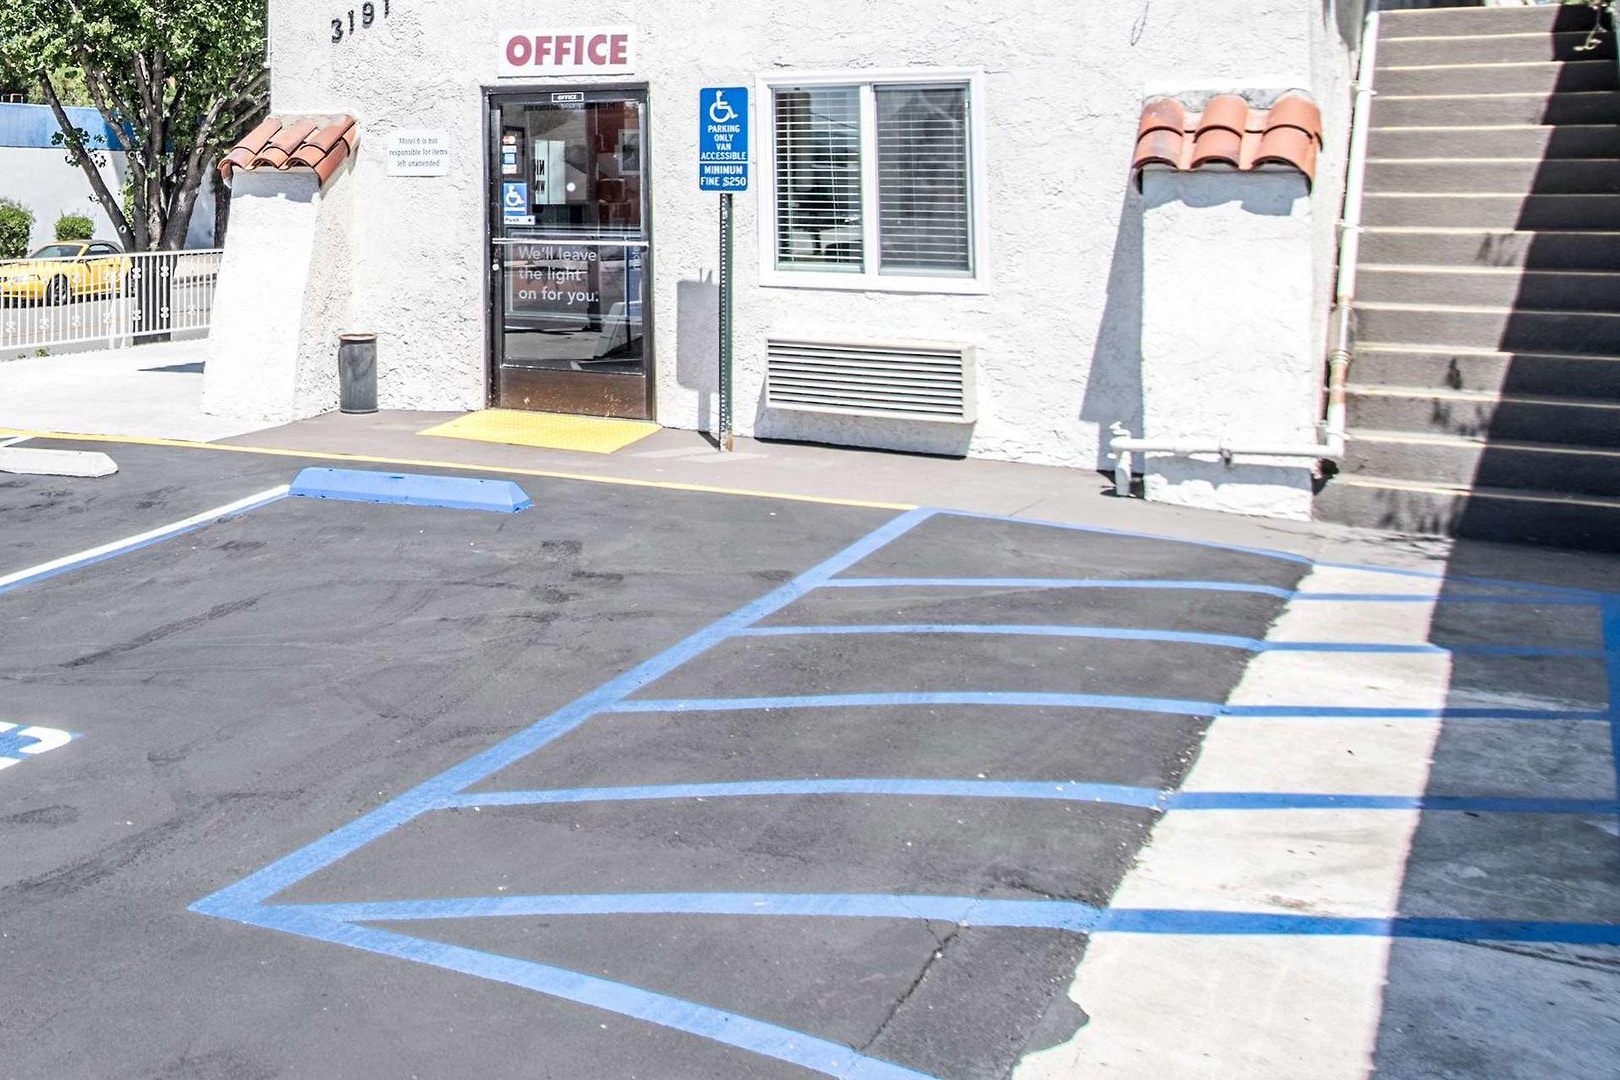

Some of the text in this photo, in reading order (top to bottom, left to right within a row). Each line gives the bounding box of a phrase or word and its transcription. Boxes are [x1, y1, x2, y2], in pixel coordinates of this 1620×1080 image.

[505, 34, 629, 67] OFFICE
[707, 125, 740, 133] PARKING
[714, 134, 733, 142] ONLY
[716, 143, 732, 151] VAN
[389, 149, 421, 157] responsible
[701, 152, 747, 160] ACCESSIBLE
[704, 165, 743, 175] MINIMUM
[700, 177, 748, 187] FINE $250
[518, 246, 597, 261] We'll leave
[519, 265, 582, 284] the light
[519, 289, 537, 300] on
[541, 286, 563, 300] for
